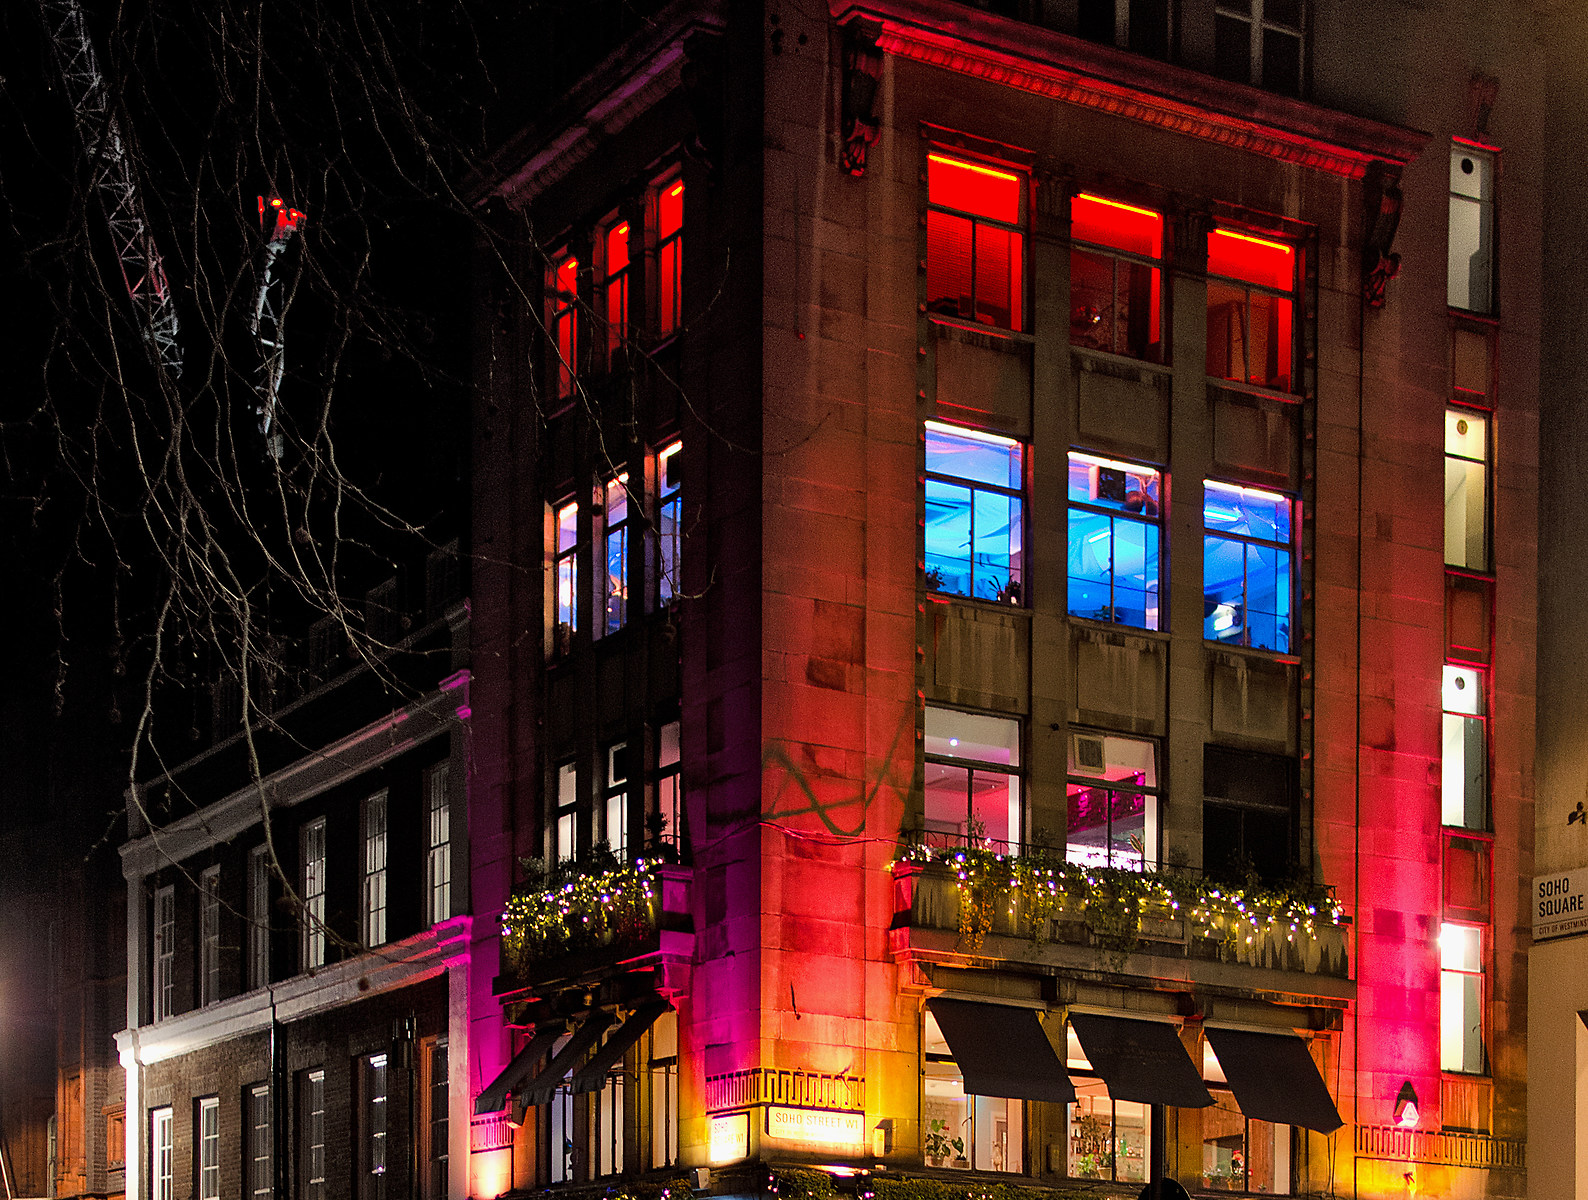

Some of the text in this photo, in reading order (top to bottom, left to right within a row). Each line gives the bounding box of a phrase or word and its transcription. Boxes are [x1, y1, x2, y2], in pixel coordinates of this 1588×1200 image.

[1539, 877, 1569, 898] SOHO
[1539, 895, 1584, 917] SQUARE
[1539, 927, 1550, 935] CITY
[1559, 918, 1588, 931] WESTMINS
[775, 1112, 802, 1124] SOHO
[806, 1115, 840, 1128] STREET
